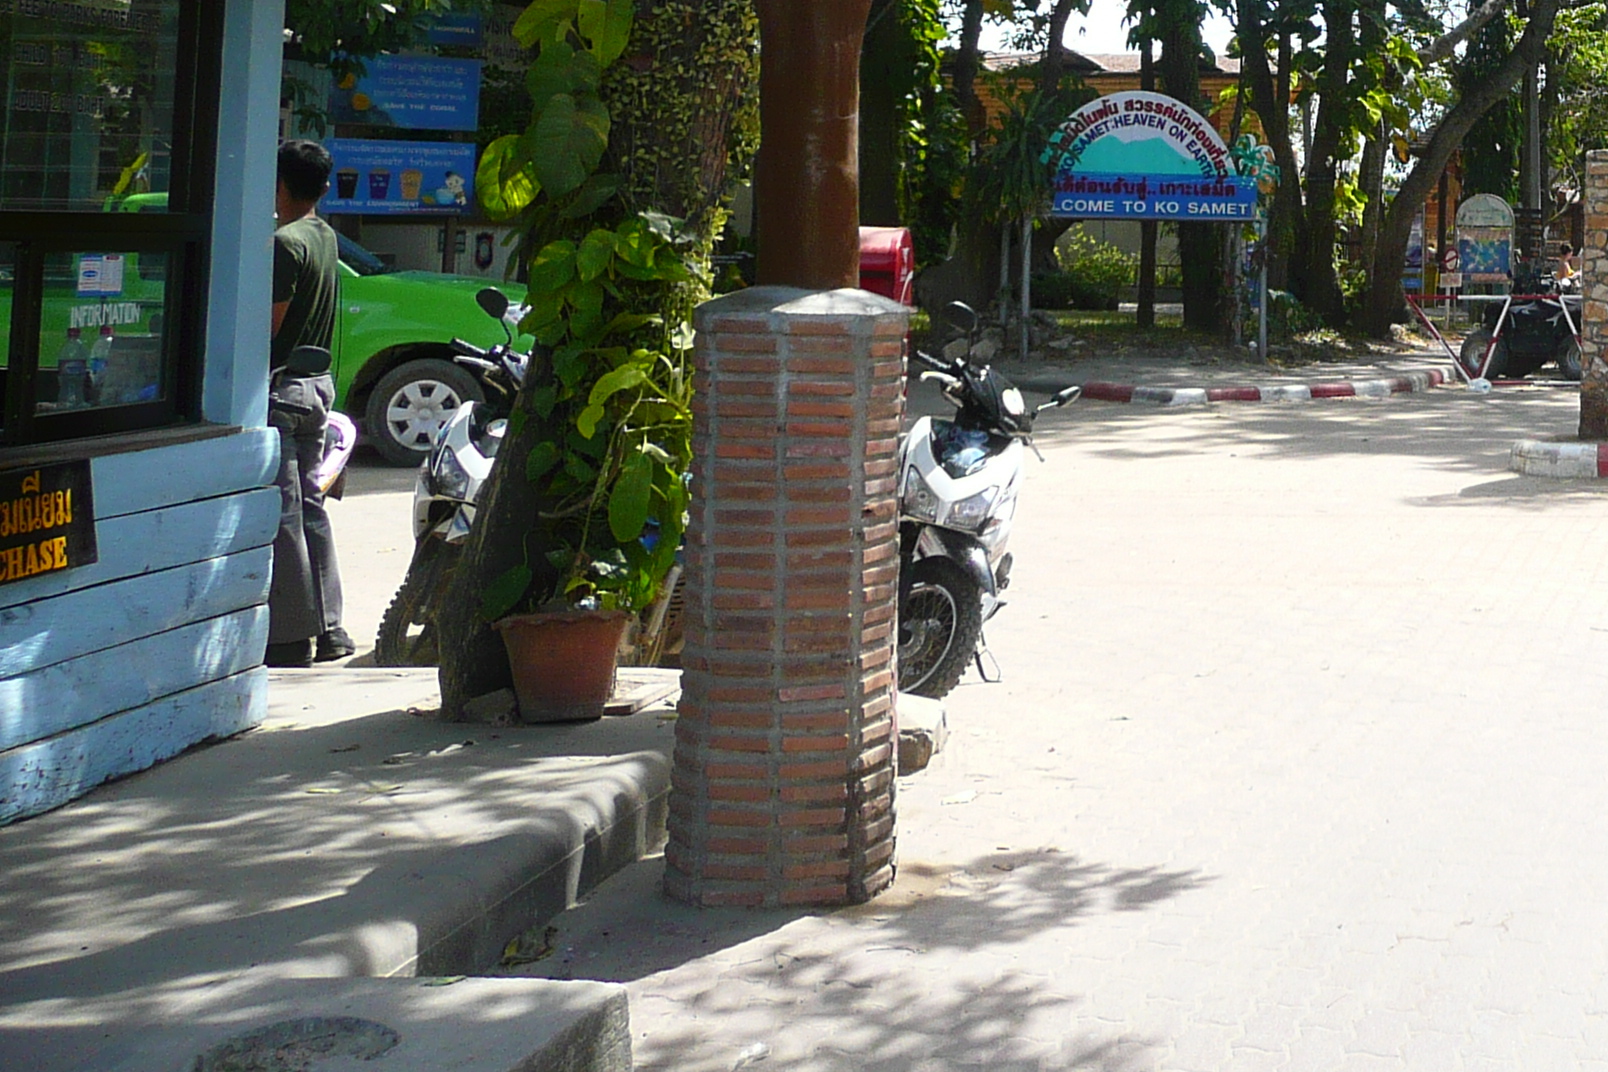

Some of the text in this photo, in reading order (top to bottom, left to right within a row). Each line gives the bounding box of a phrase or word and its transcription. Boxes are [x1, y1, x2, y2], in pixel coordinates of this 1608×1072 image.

[1169, 125, 1188, 143] ON
[1185, 139, 1215, 179] EARTH
[1122, 200, 1147, 214] TO
[1154, 201, 1180, 215] KO
[1187, 202, 1249, 216] SAMET
[70, 302, 142, 328] INFORMATION
